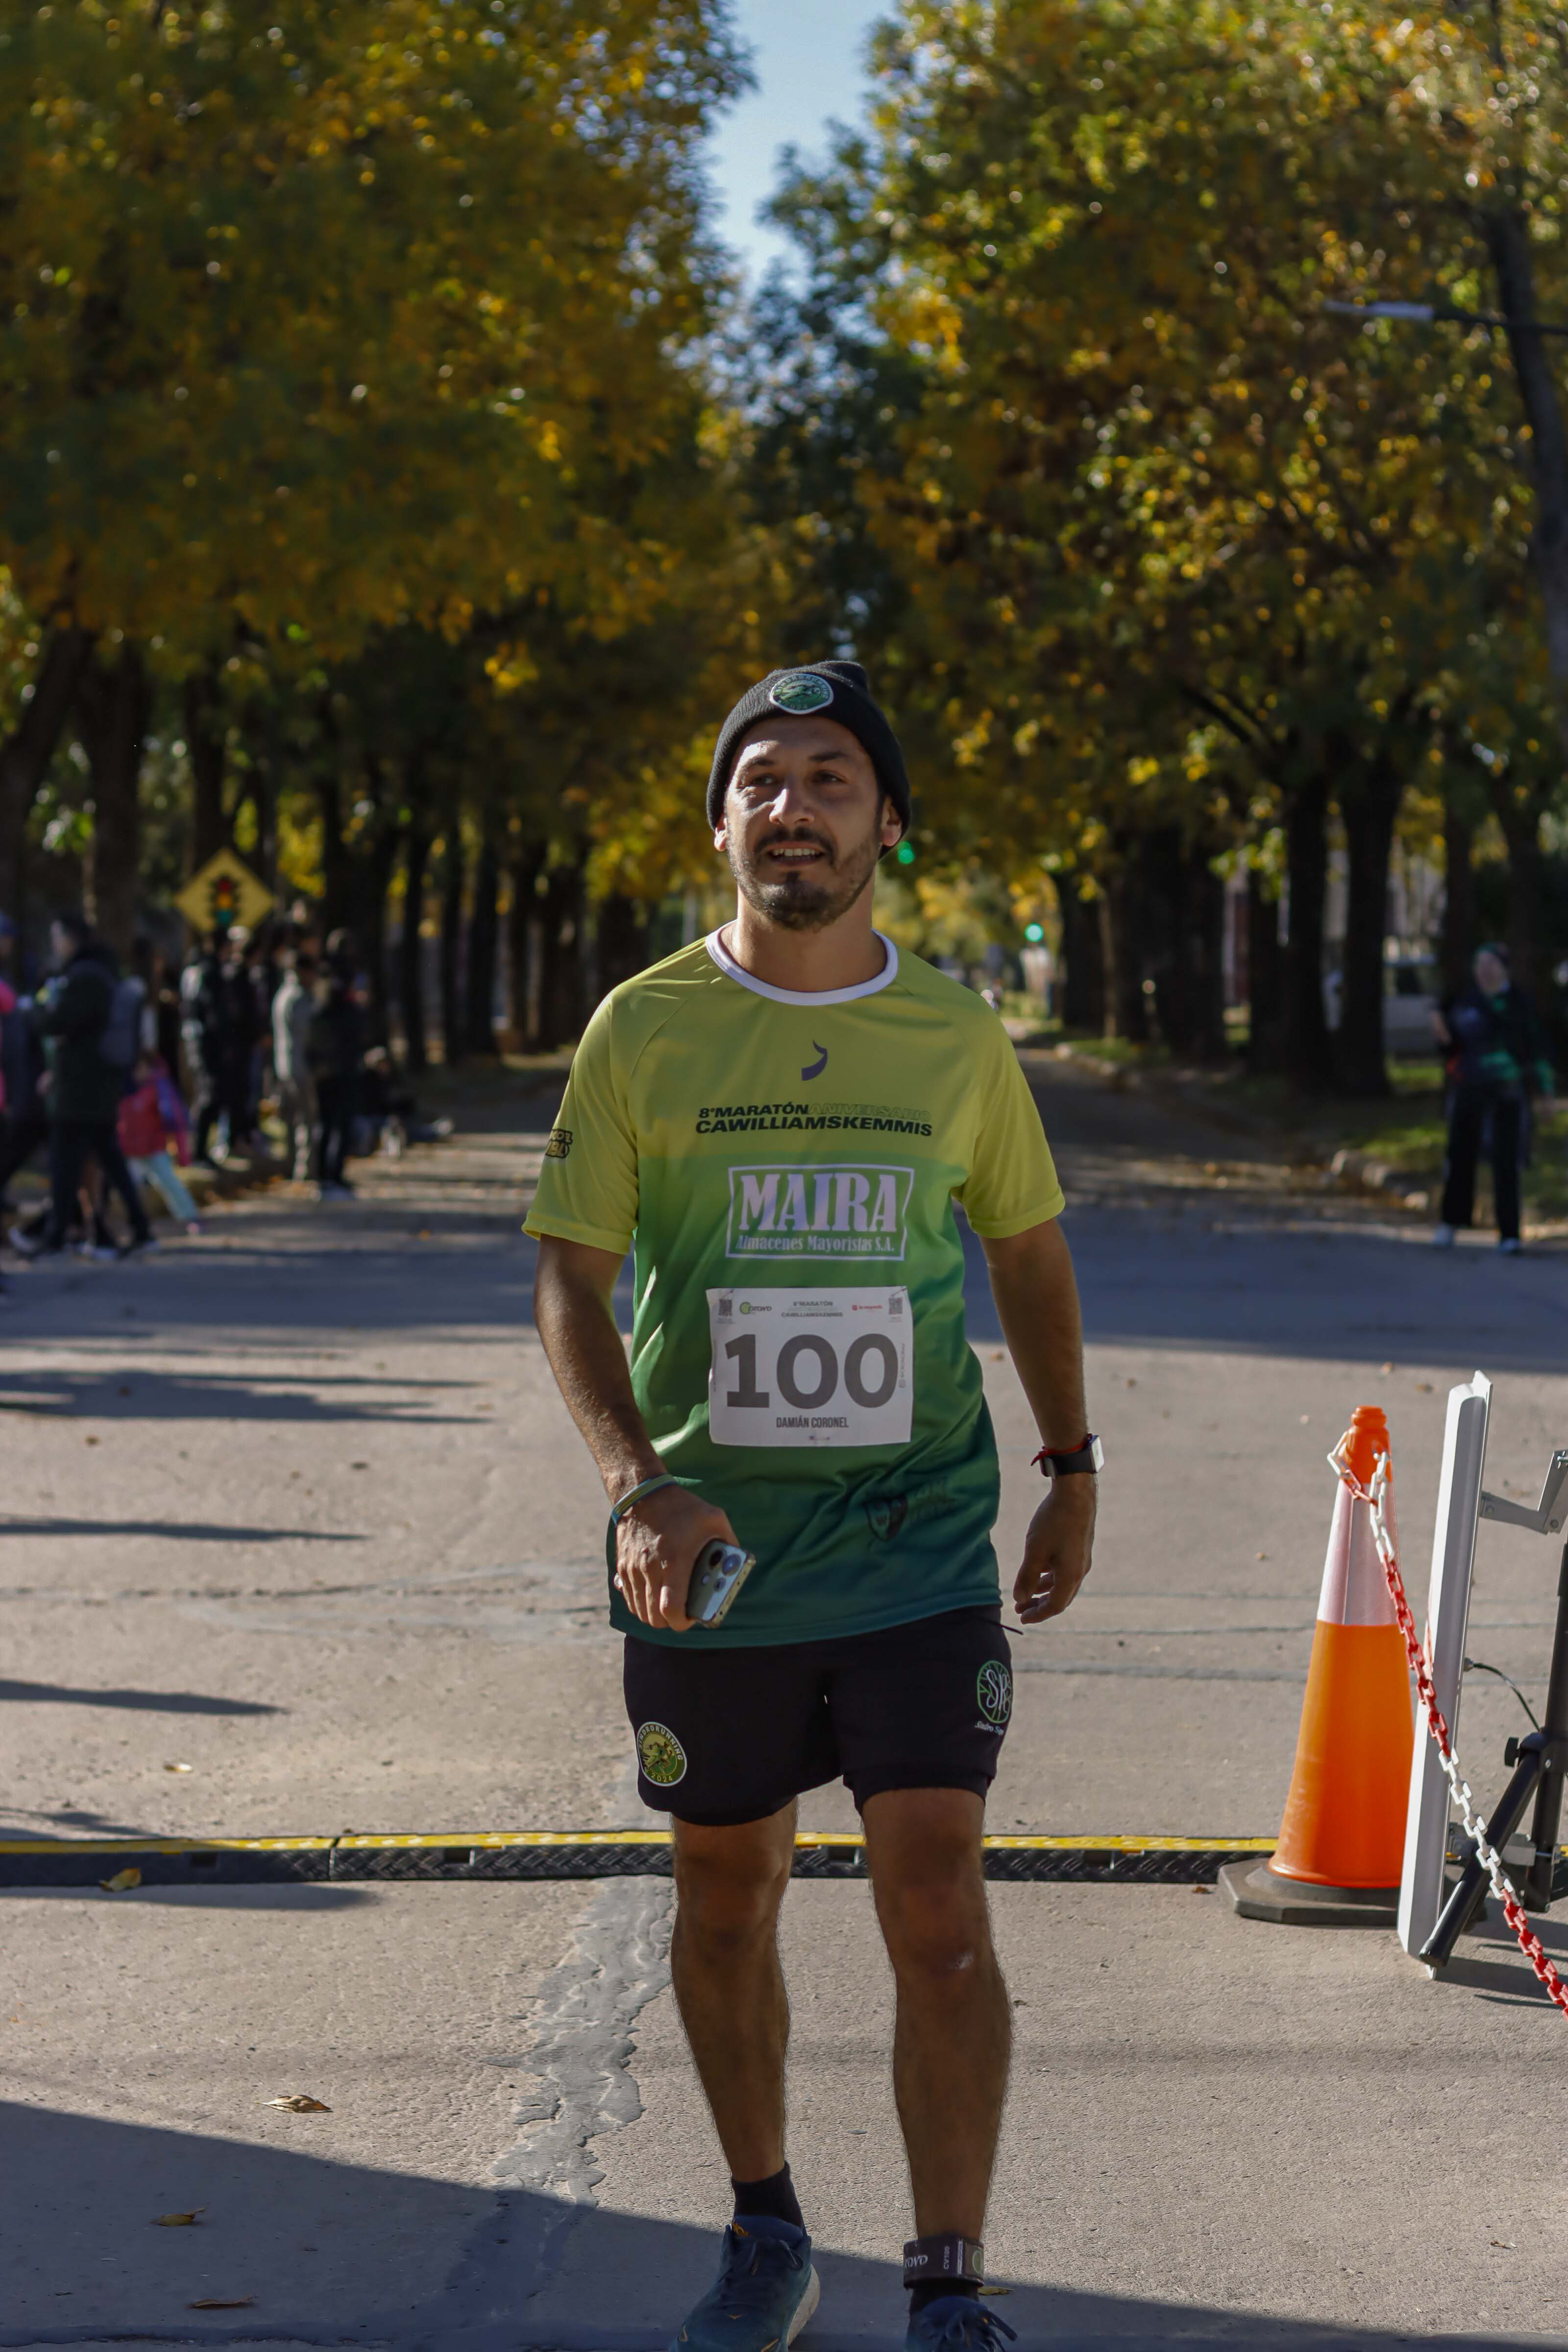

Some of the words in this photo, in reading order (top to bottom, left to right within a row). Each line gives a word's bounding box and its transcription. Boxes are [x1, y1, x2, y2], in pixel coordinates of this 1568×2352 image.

[696, 1116, 932, 1136] CAWILLIAMSKEMMIS
[738, 1173, 897, 1232] MAIRA
[735, 1234, 804, 1250] Almacenes
[807, 1235, 872, 1252] Mayoristas
[875, 1237, 895, 1251] S.A.
[725, 1333, 899, 1409] 100
[776, 1415, 809, 1428] DAMIÁN
[811, 1417, 849, 1428] CORONEL
[638, 1724, 684, 1761] SINDRORUNNING
[651, 1772, 673, 1783] 2024
